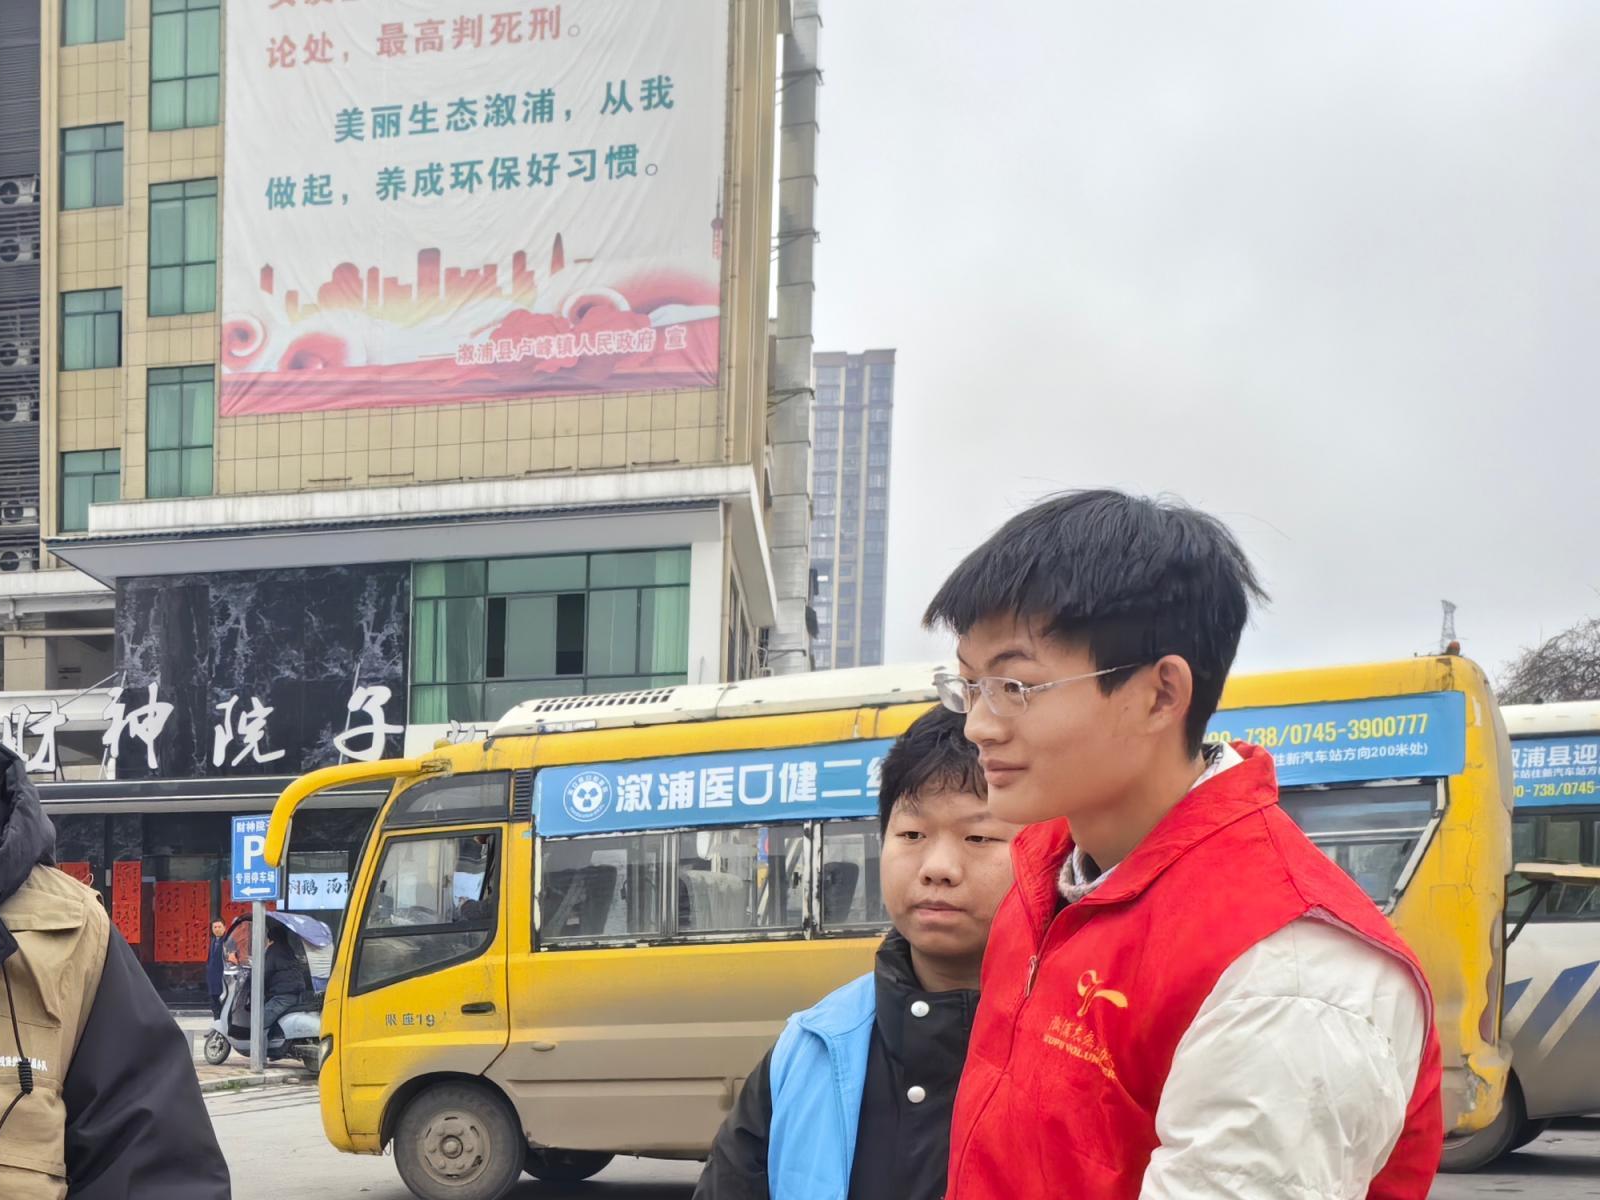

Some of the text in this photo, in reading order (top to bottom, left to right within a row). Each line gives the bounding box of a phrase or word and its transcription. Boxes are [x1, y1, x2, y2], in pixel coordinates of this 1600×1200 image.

[267, 5, 581, 69] 论处，最高判死刑。
[334, 75, 675, 144] 美丽生态溆浦，从我
[265, 143, 659, 210] 做起，养成环保好习惯。
[3, 682, 404, 772] 财神院子
[243, 835, 268, 870] P
